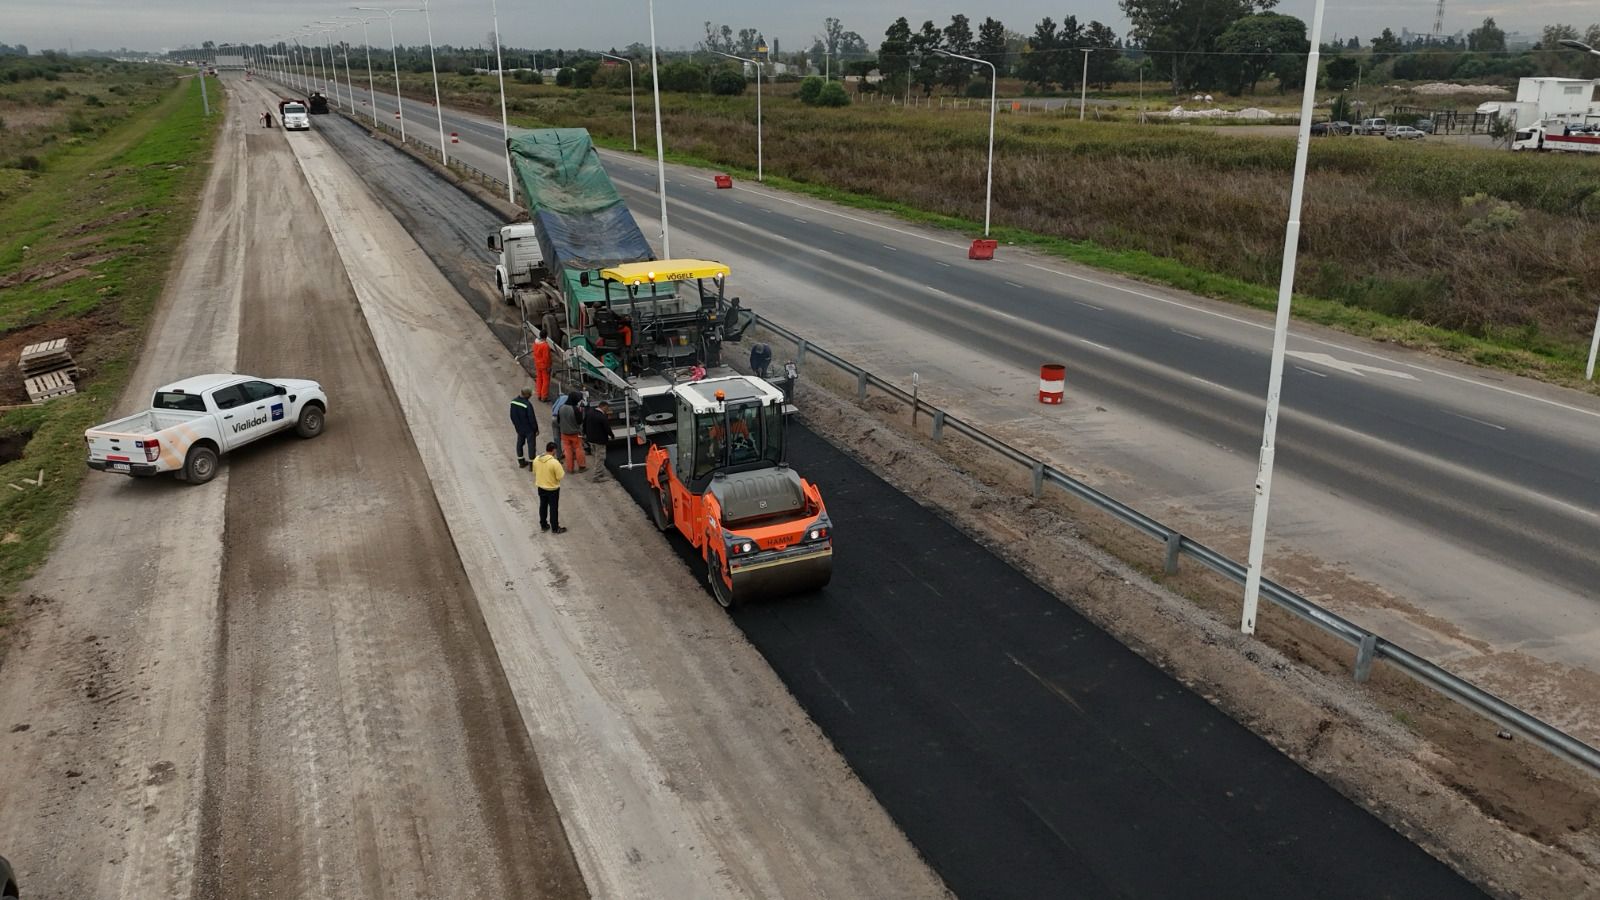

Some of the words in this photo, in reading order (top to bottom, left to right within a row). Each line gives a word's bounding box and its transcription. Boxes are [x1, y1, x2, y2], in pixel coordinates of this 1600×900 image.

[666, 272, 694, 280] VÖGELE
[232, 413, 267, 433] Vialidad
[767, 535, 793, 546] HAMM
